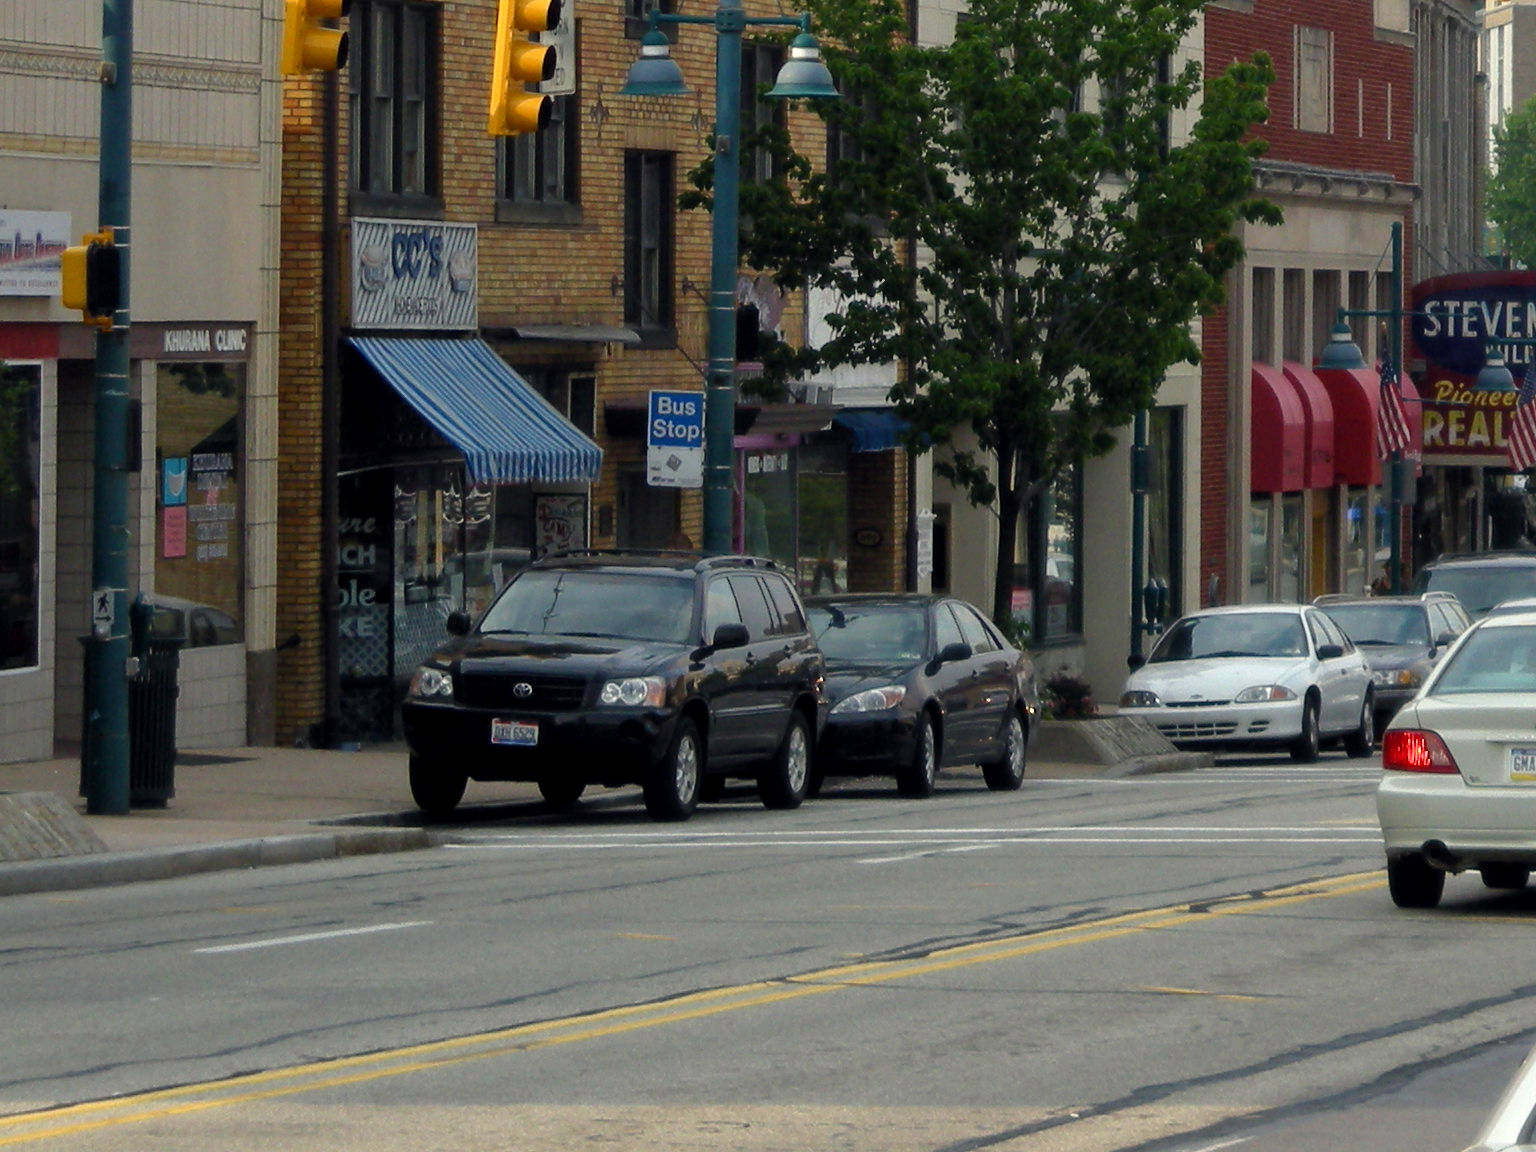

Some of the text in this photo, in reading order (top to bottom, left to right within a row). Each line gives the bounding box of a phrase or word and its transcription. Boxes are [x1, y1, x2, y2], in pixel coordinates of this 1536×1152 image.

[164, 328, 247, 352] KHURANA CLINIC
[1435, 380, 1519, 407] Pionee
[657, 396, 696, 416] Bus
[653, 419, 700, 442] Stop
